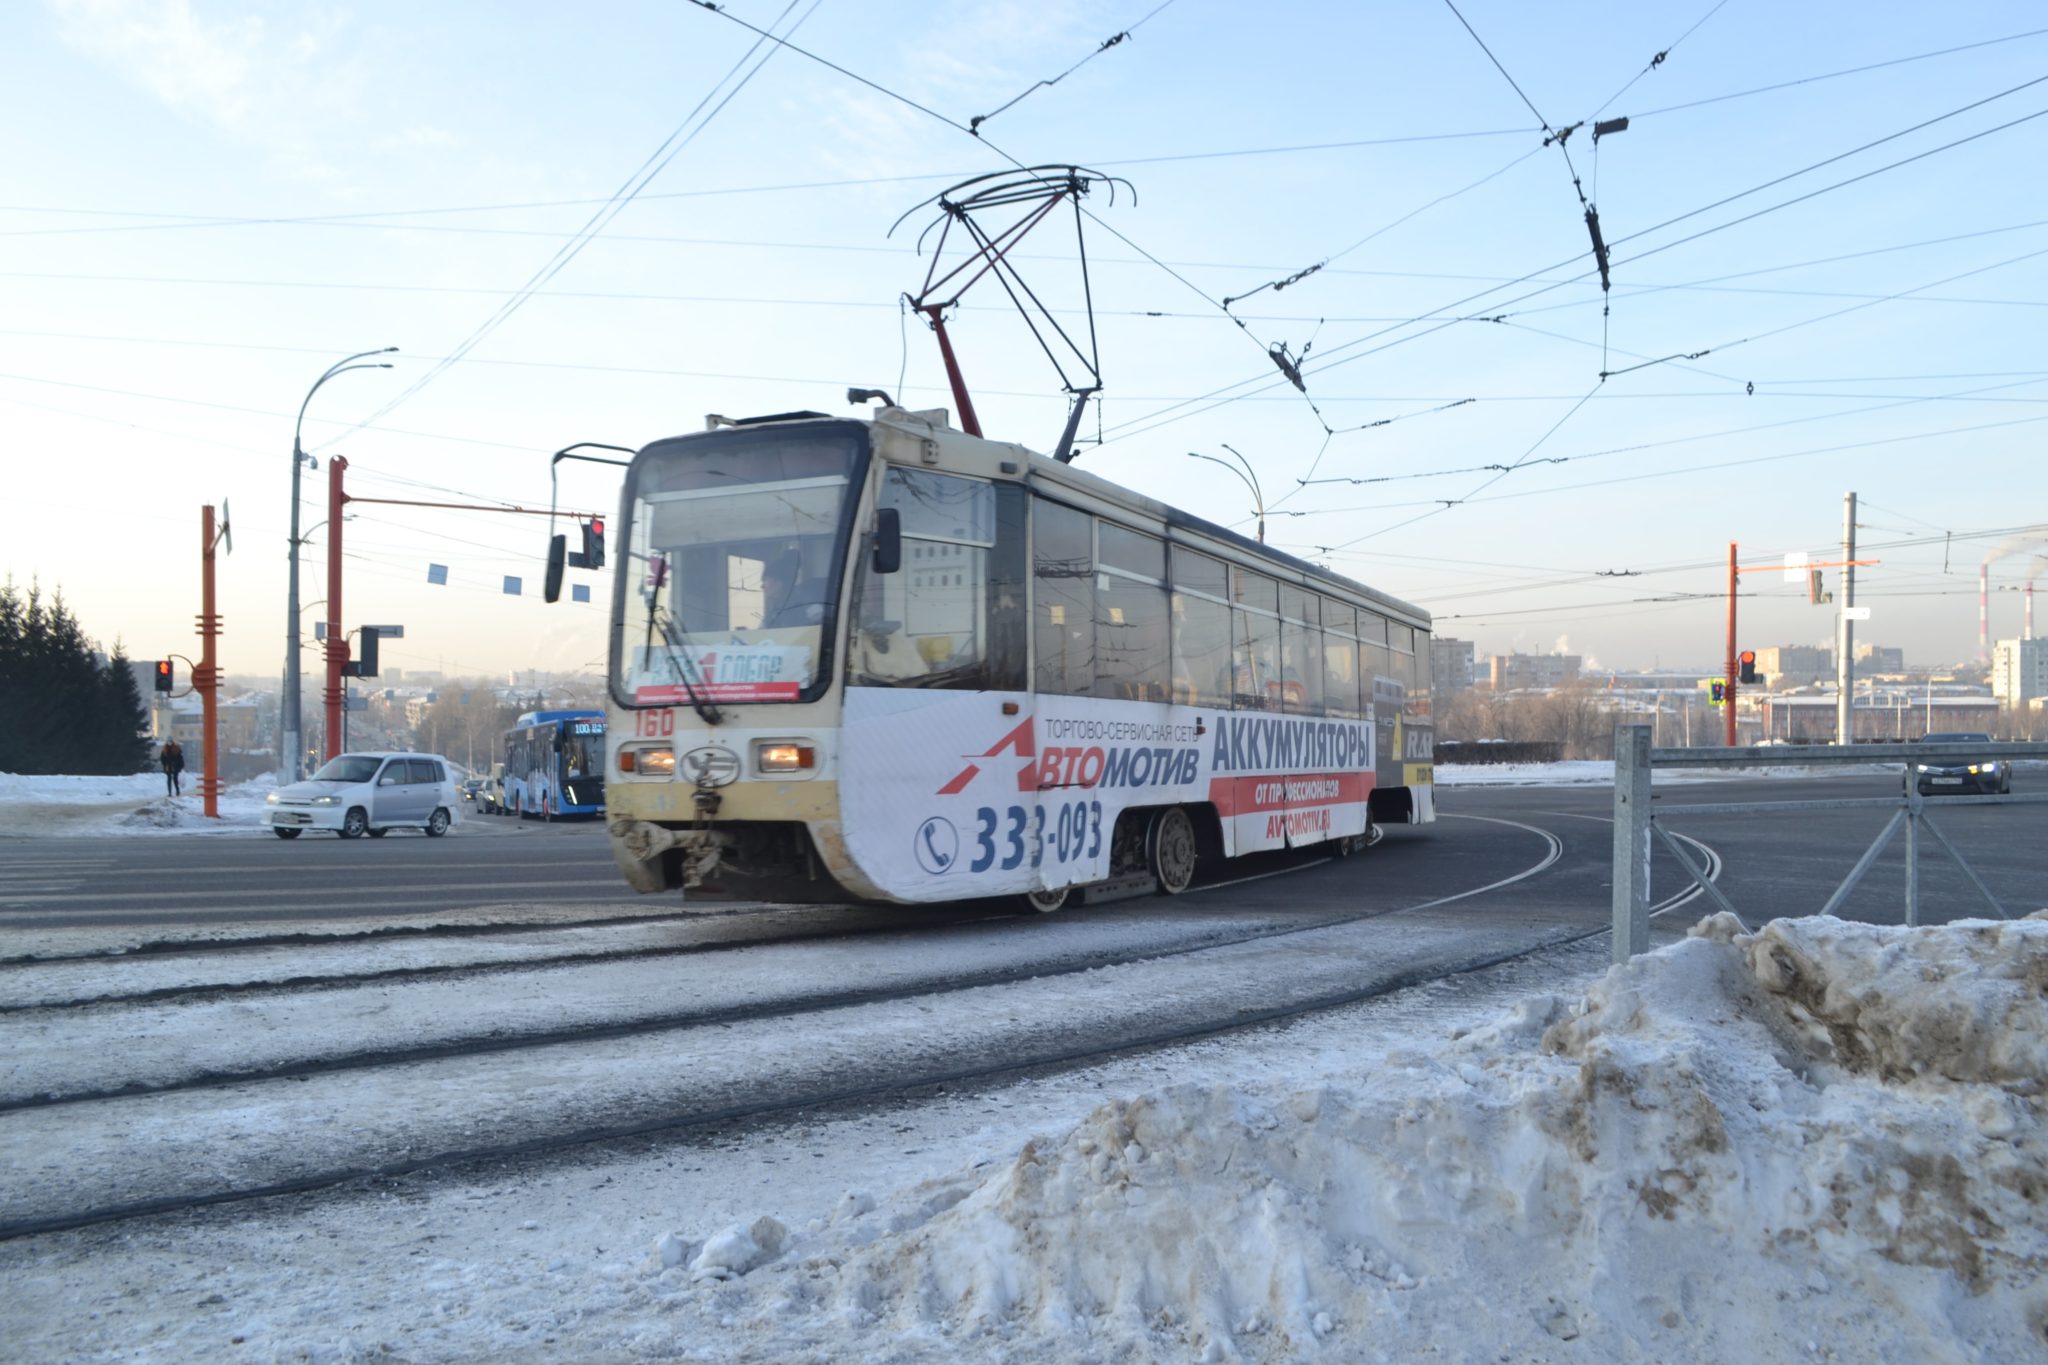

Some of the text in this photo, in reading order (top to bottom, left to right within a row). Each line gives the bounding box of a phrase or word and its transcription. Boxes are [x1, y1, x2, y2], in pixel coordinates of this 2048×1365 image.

[636, 709, 674, 737] 160
[1045, 719, 1199, 742] ТОРГОВО-СЕРВИСНАЯ СЕТЬ
[1212, 716, 1370, 771] АККУМУЛЯТОРЫ
[1255, 783, 1267, 805] ОТ
[970, 801, 1103, 873] 333-093
